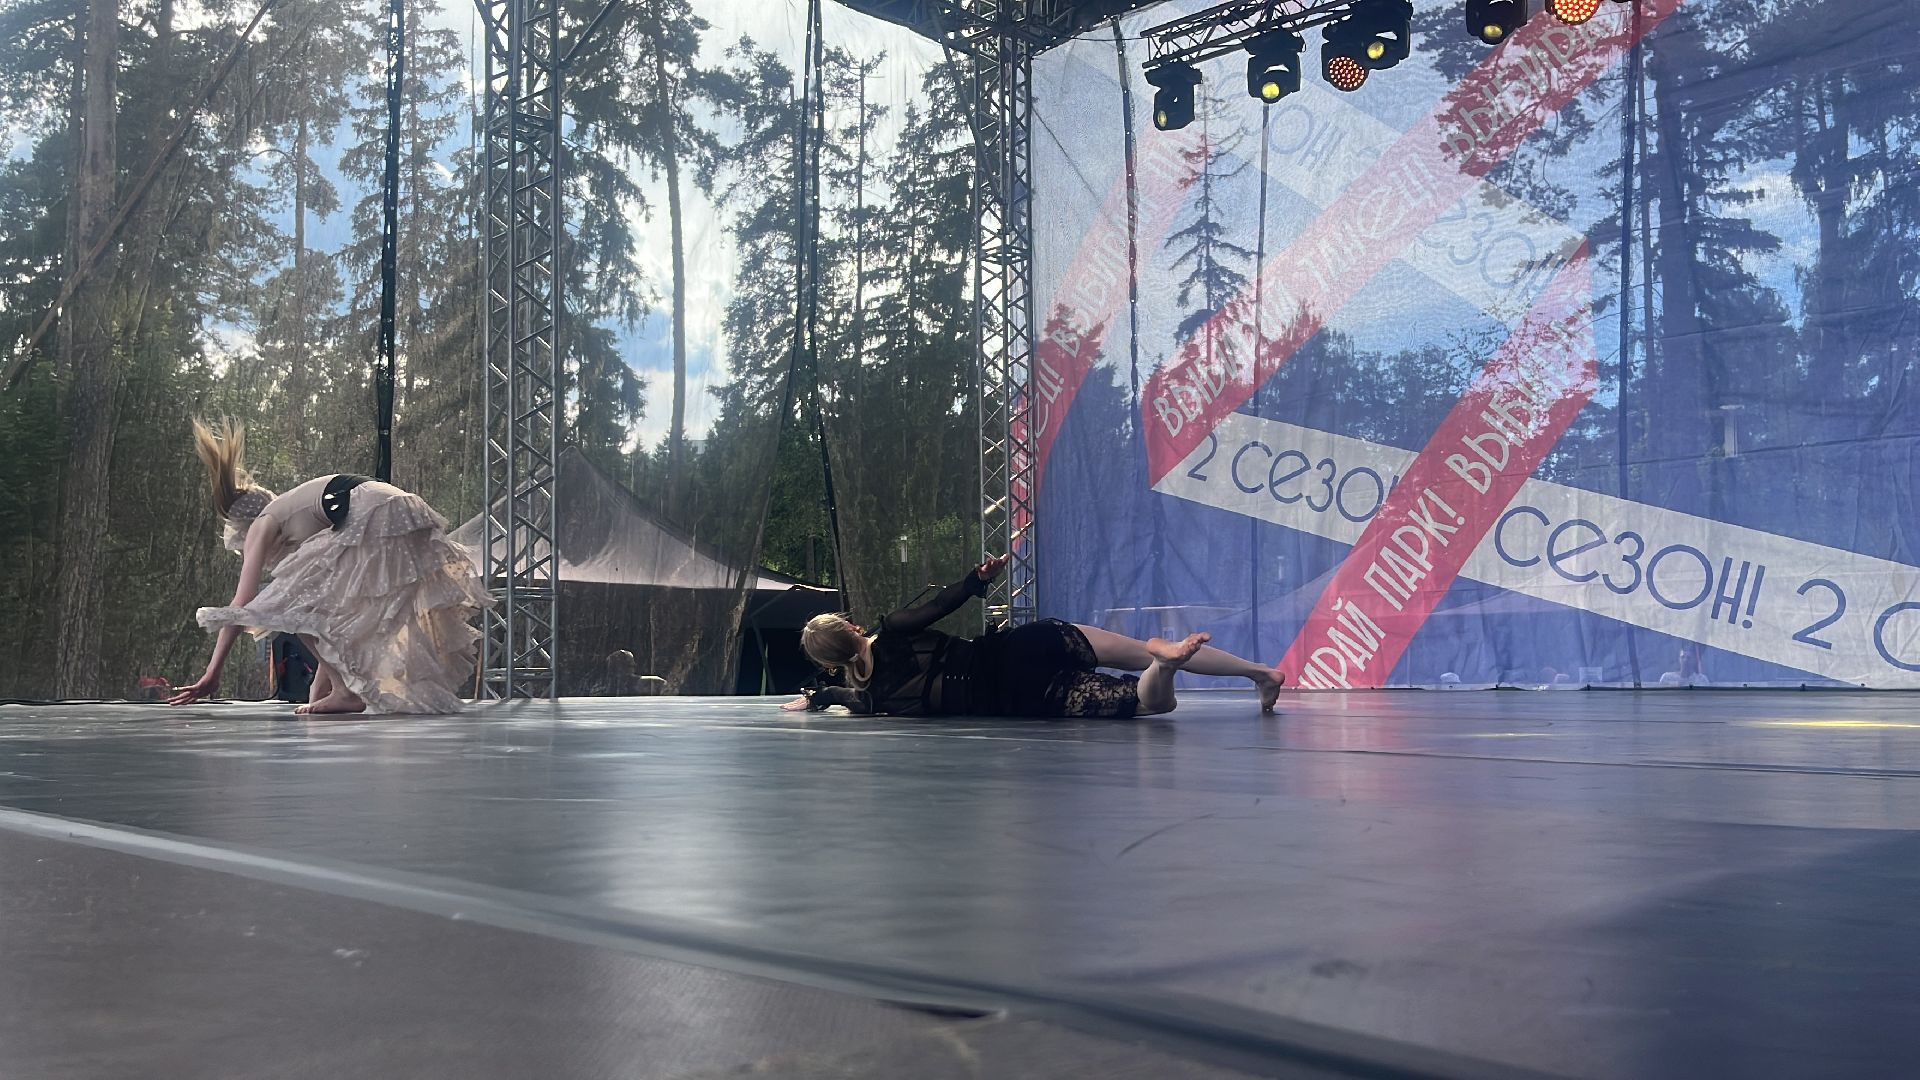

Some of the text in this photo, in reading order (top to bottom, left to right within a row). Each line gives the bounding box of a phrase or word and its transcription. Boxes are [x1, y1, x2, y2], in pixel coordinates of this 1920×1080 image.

[1444, 20, 1612, 166] ВЫБИРА
[1187, 432, 1218, 482] 2
[1231, 440, 1399, 523] СЕЗО
[1792, 578, 1847, 650] 2
[1363, 488, 1466, 612] ПАРК!
